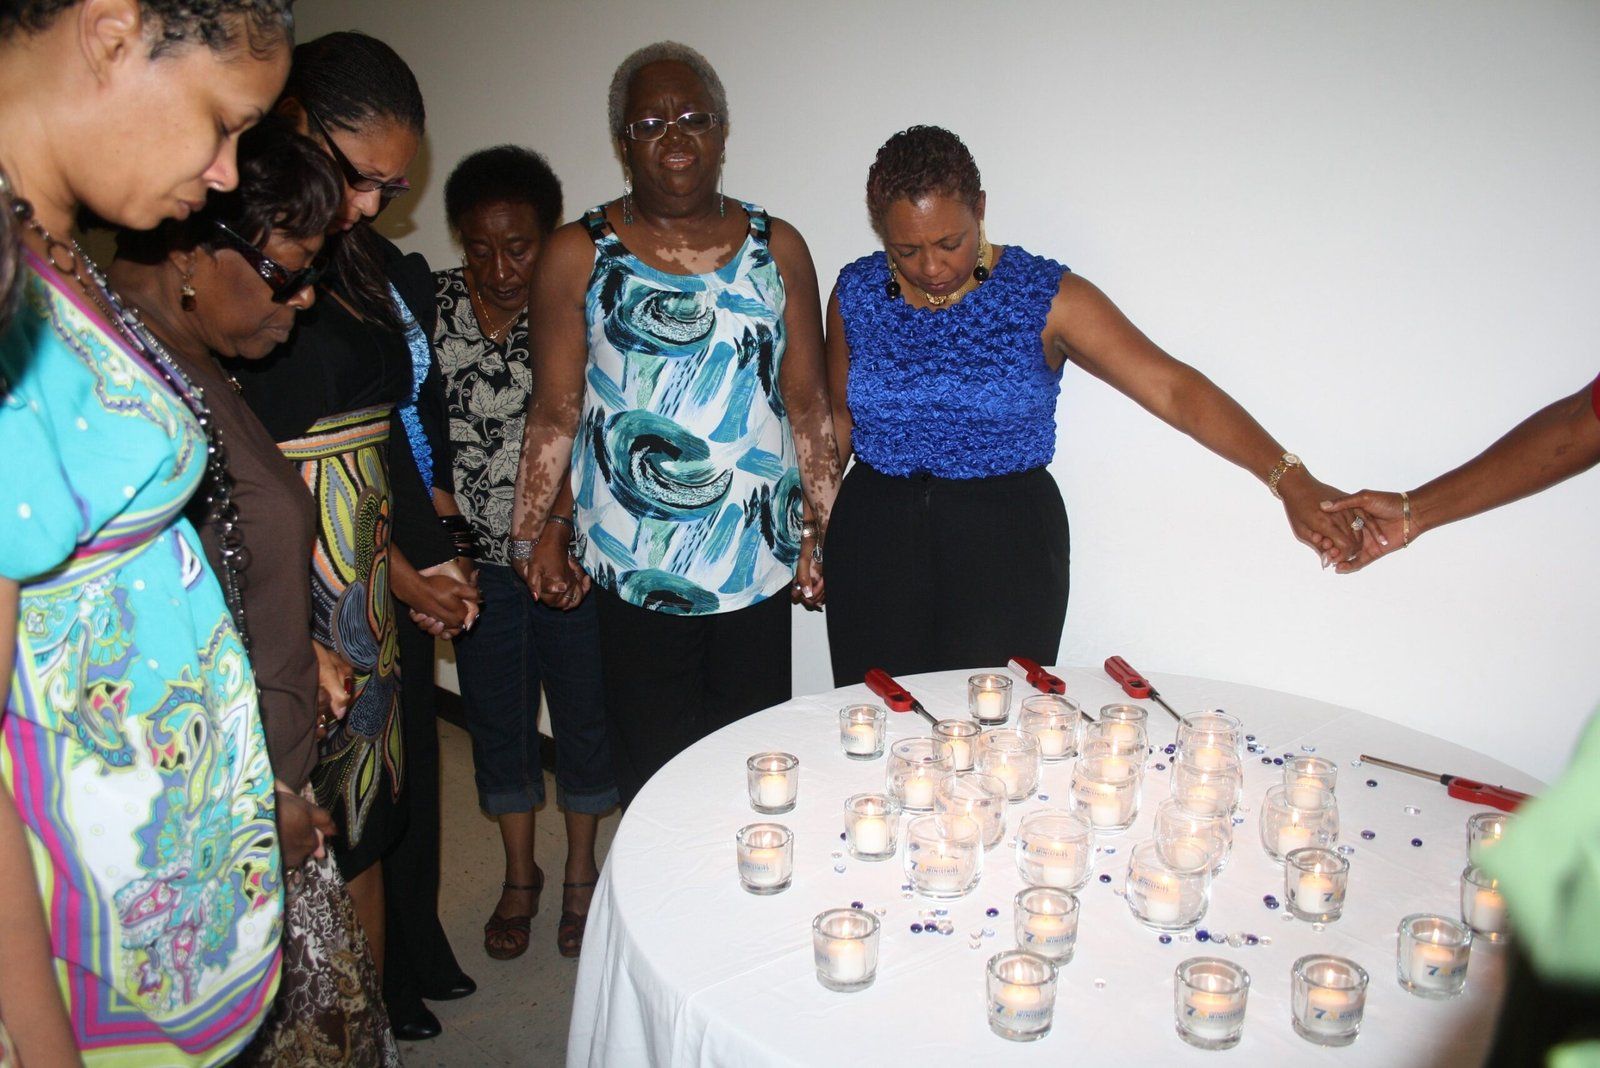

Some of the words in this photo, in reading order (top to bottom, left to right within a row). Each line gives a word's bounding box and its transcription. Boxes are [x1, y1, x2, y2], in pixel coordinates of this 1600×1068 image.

[1022, 840, 1029, 851] 7
[911, 860, 918, 871] 7
[1323, 892, 1335, 902] 7
[1024, 931, 1035, 943] 7
[1426, 965, 1439, 976] 7
[994, 1001, 1005, 1013] 7
[1185, 1004, 1196, 1016] 7
[1312, 1007, 1327, 1019] 7
